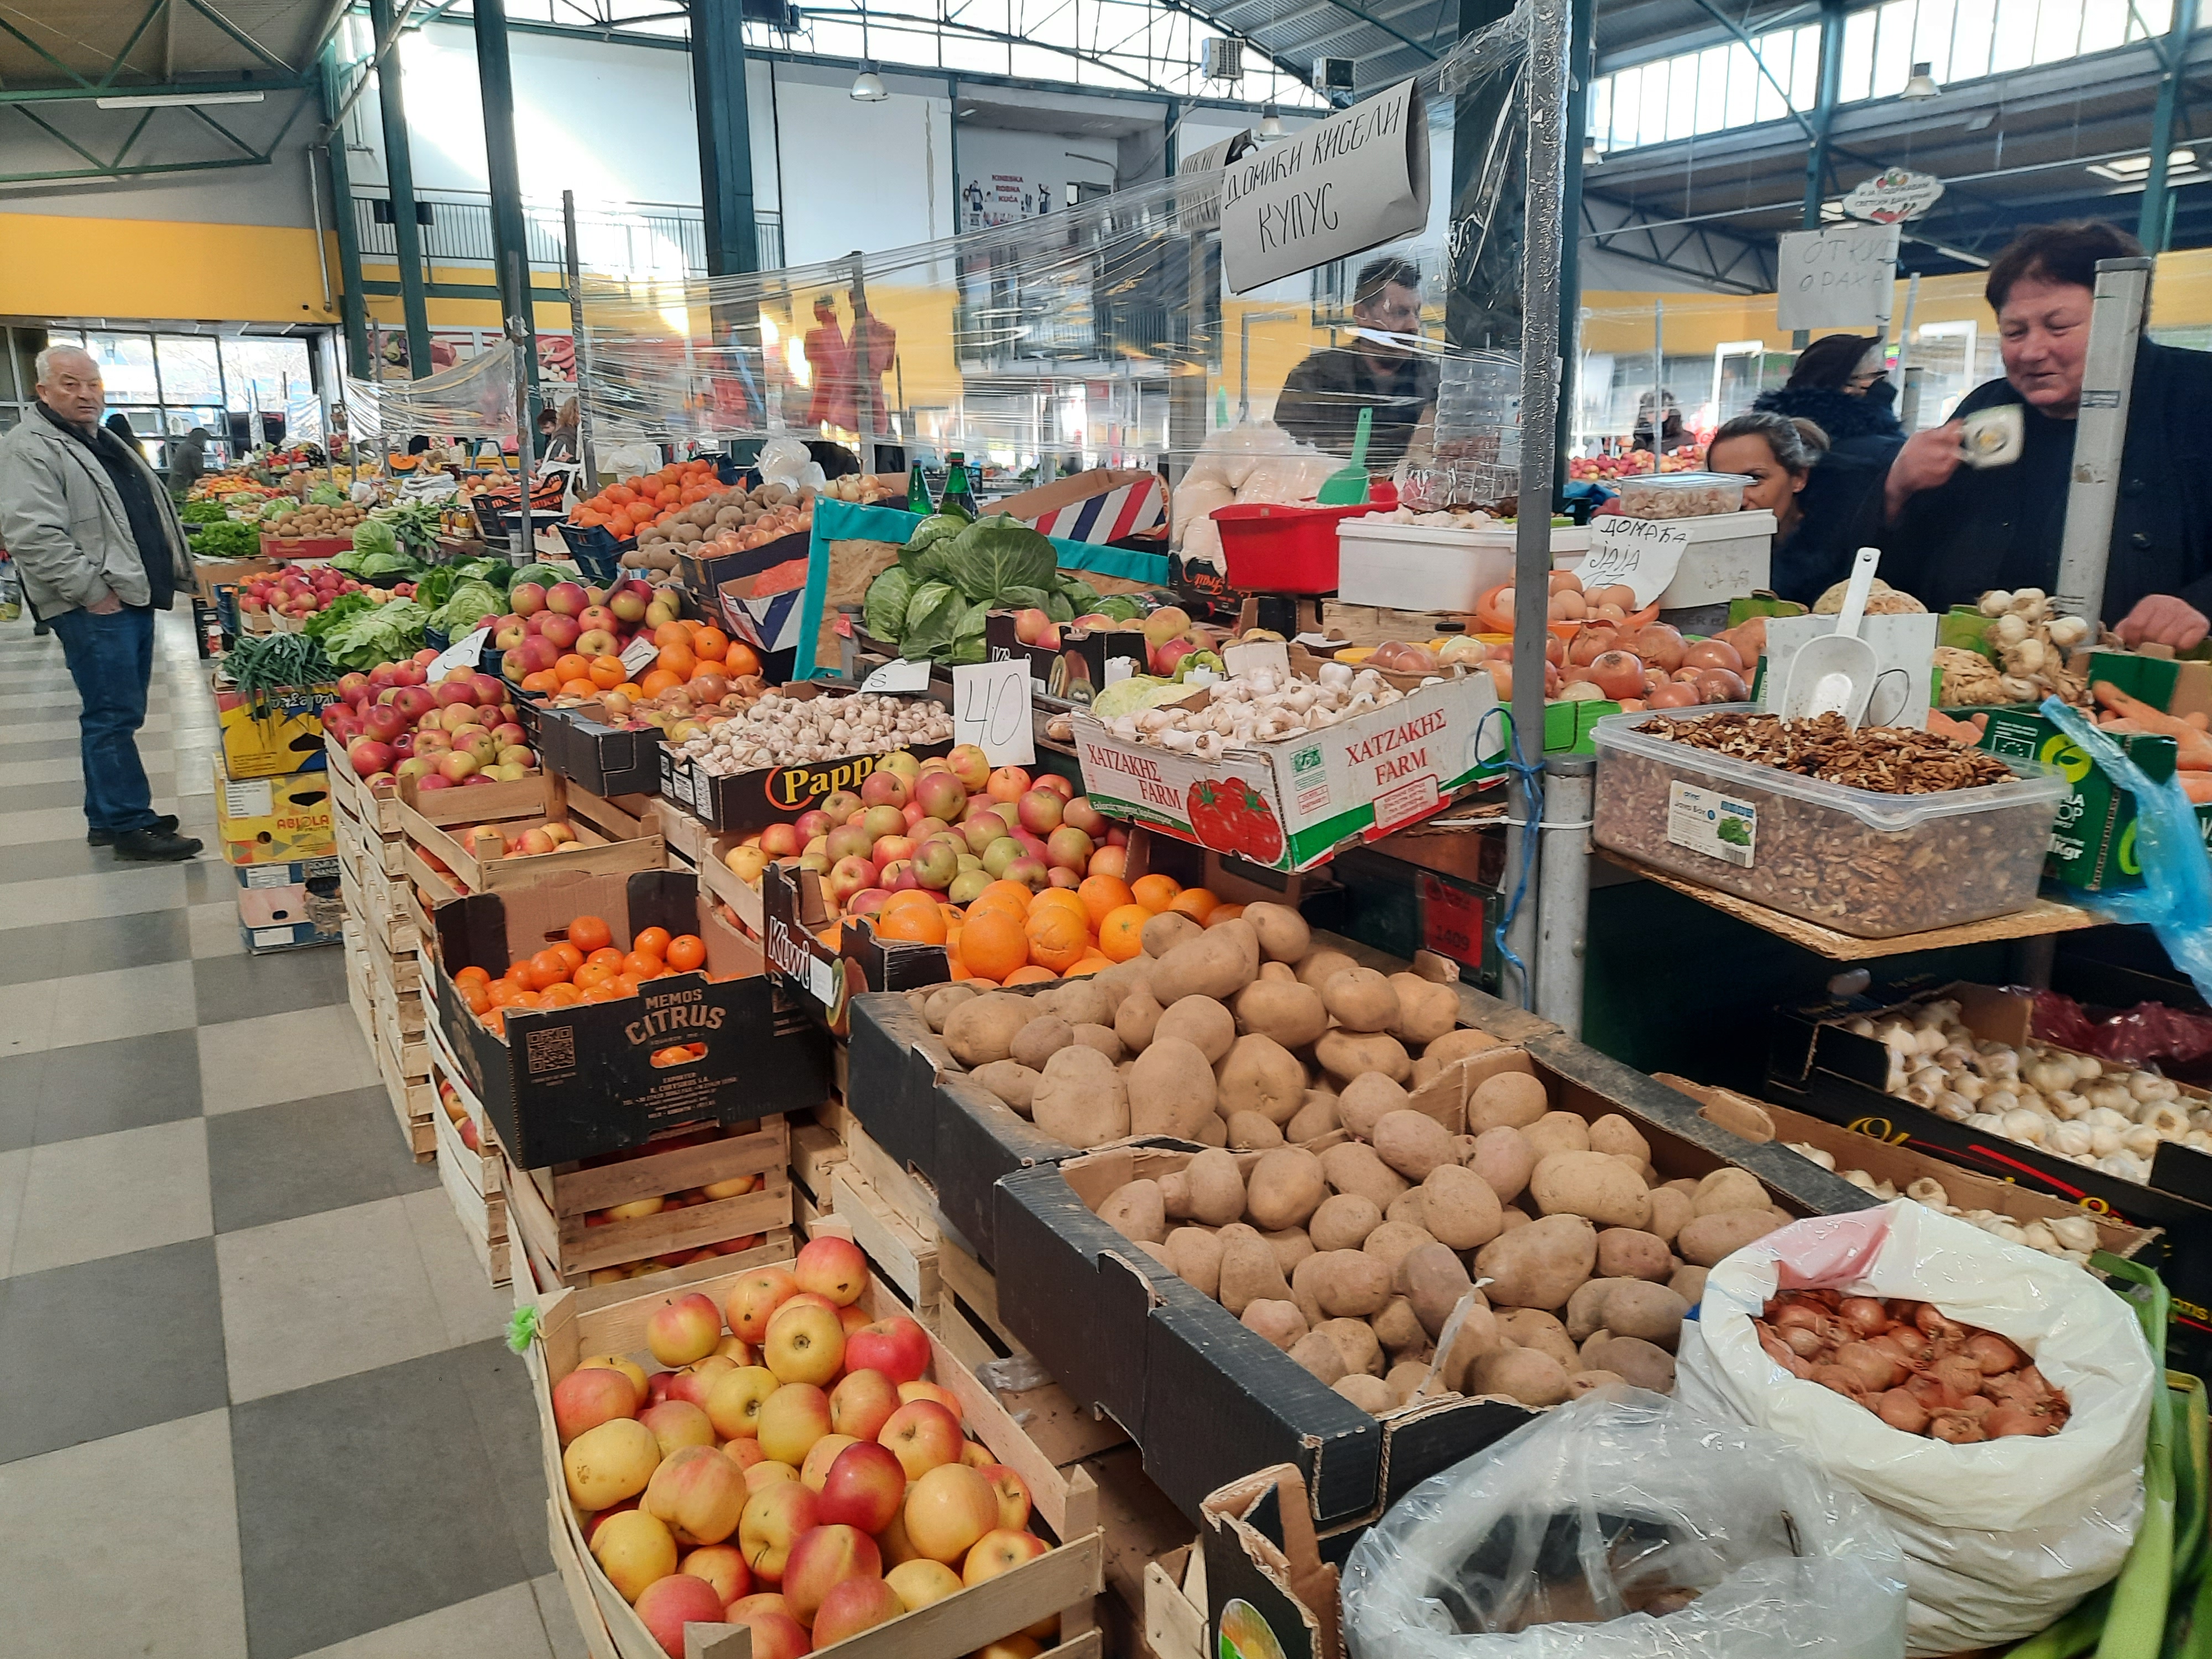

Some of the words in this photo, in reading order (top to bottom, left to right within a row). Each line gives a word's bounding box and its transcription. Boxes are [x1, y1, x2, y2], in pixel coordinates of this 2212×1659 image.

[1224, 140, 1303, 210] ДОМАЋИ
[1312, 96, 1402, 166] КИСЕЛИ
[1258, 182, 1339, 253] КУПУС
[964, 672, 1023, 748] 40
[1867, 669, 1910, 728] 0
[1086, 743, 1162, 783] ΧΑΤΖΑΚΗΣ
[1345, 708, 1447, 768] ΧΑΤΖΑΚΗΣ
[782, 743, 910, 804] Papp
[1374, 747, 1428, 786] FARM
[1137, 779, 1183, 811] FARM
[276, 815, 330, 830] ABIOLA
[645, 988, 703, 1010] MEMOS
[624, 1004, 727, 1045] CITRUS
